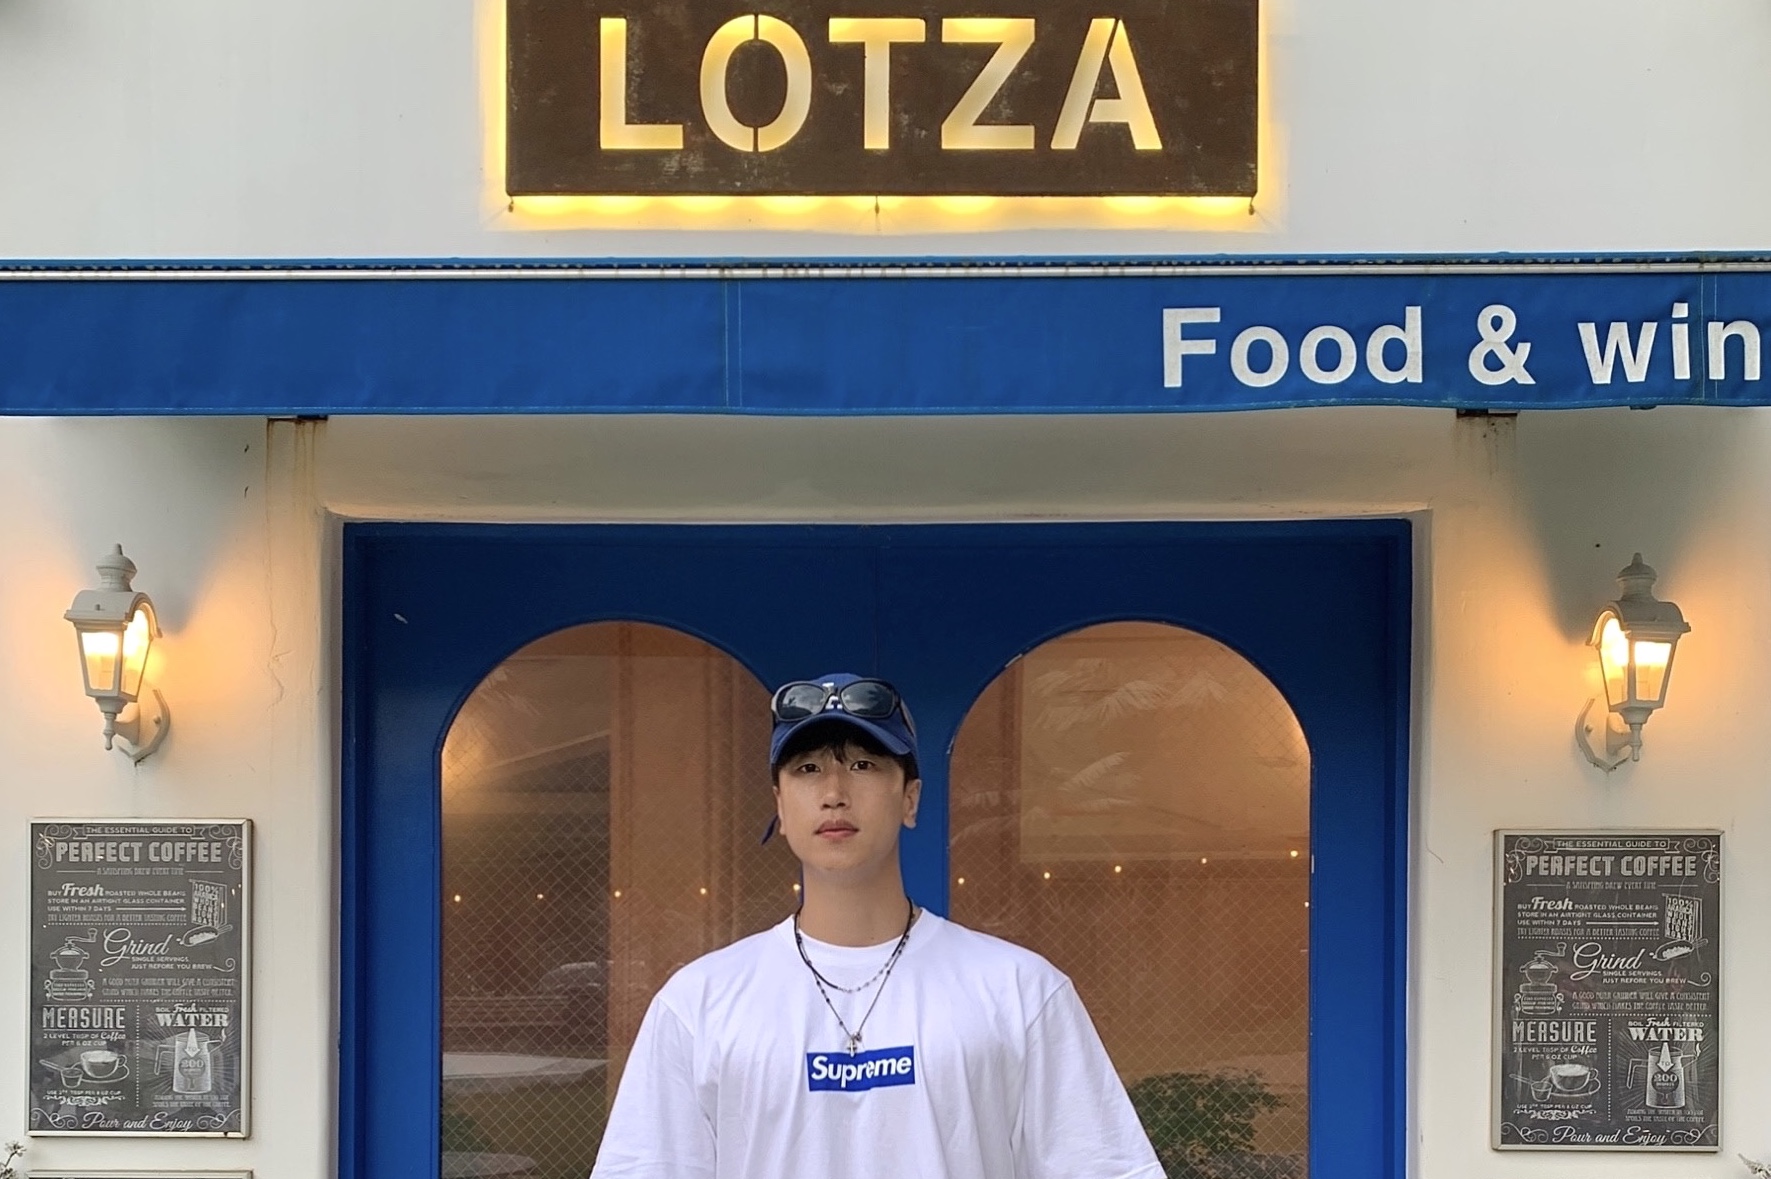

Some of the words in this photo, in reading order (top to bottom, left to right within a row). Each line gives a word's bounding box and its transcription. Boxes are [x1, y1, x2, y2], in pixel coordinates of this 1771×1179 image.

[600, 14, 1162, 152] LOTZA
[1162, 306, 1422, 388] Food
[1468, 304, 1536, 386] &
[1577, 302, 1761, 386] win
[86, 826, 102, 834] THE
[104, 826, 150, 834] ESSENTIAL
[151, 826, 178, 834] GUIDE
[181, 826, 193, 834] TO
[55, 842, 143, 862] PERFECT
[148, 842, 222, 862] COFFEE
[1526, 855, 1615, 877] PERFECT
[1620, 855, 1697, 877] COFFEE
[61, 882, 104, 897] Fresh
[1531, 896, 1573, 911] Fresh
[100, 927, 173, 967] Grind
[1570, 942, 1646, 981] Grind
[42, 1007, 126, 1029] MEASURE
[155, 1013, 229, 1027] WATER
[1645, 1016, 1671, 1027] Fresh
[100, 1031, 127, 1041] Coffee
[1512, 1021, 1597, 1042] MEASURE
[1628, 1027, 1704, 1042] WATER
[1570, 1045, 1597, 1055] Coffee
[180, 1059, 205, 1068] 200
[811, 1055, 911, 1088] Supreme
[1653, 1073, 1678, 1082] 200
[82, 1112, 120, 1129] Pour
[123, 1114, 150, 1129] and
[149, 1112, 194, 1132] Enjoy
[1552, 1125, 1592, 1143] Pour
[1595, 1128, 1621, 1143] and
[1622, 1126, 1667, 1146] Enjoy
